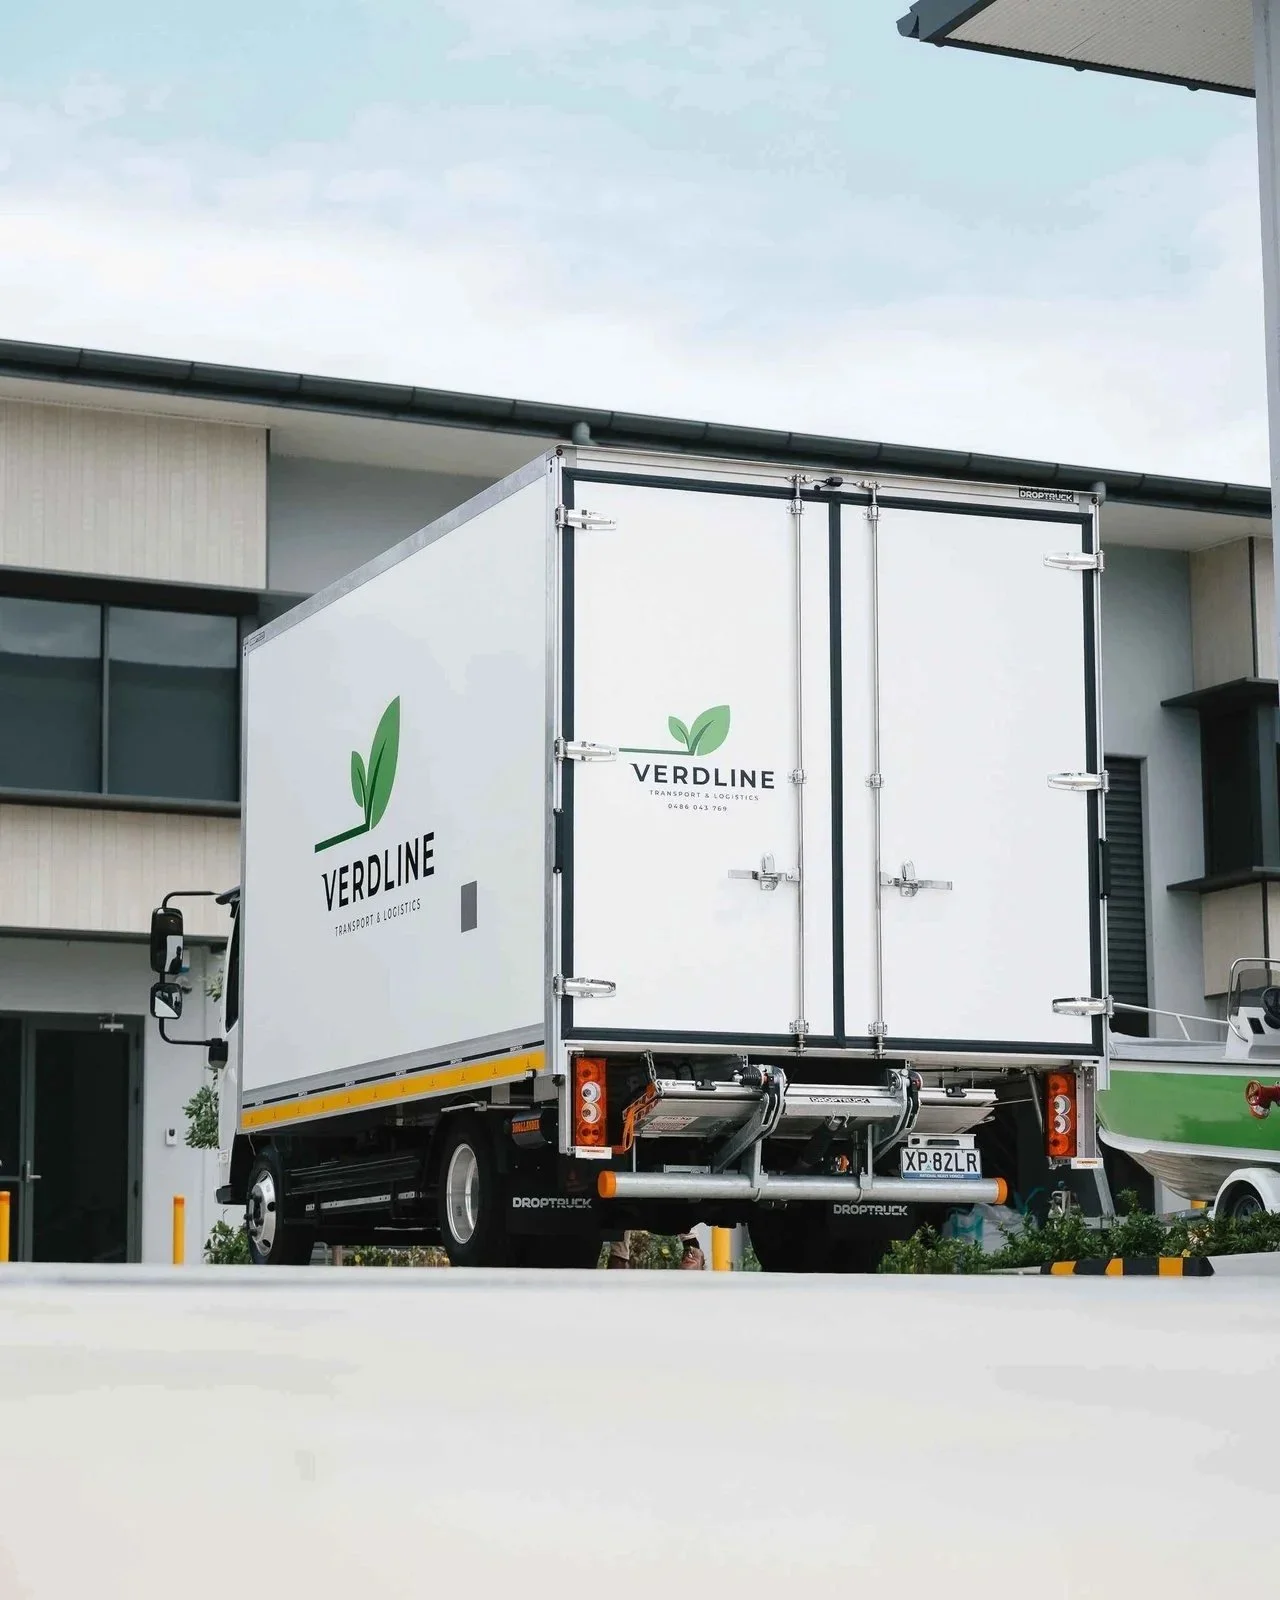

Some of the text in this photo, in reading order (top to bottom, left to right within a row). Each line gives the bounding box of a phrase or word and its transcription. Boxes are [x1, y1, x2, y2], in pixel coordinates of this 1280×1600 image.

[1020, 490, 1073, 502] DROPTRUCK
[630, 763, 774, 789] VERDLINE
[650, 789, 700, 798] TRANSPORT
[714, 793, 759, 801] LOGISTICS
[321, 831, 434, 911] VERDLINE
[335, 898, 421, 937] TRANSPORT & LOGISTICS
[512, 1196, 592, 1208] DROPTRUCK
[833, 1203, 908, 1216] DROPTRUCK
